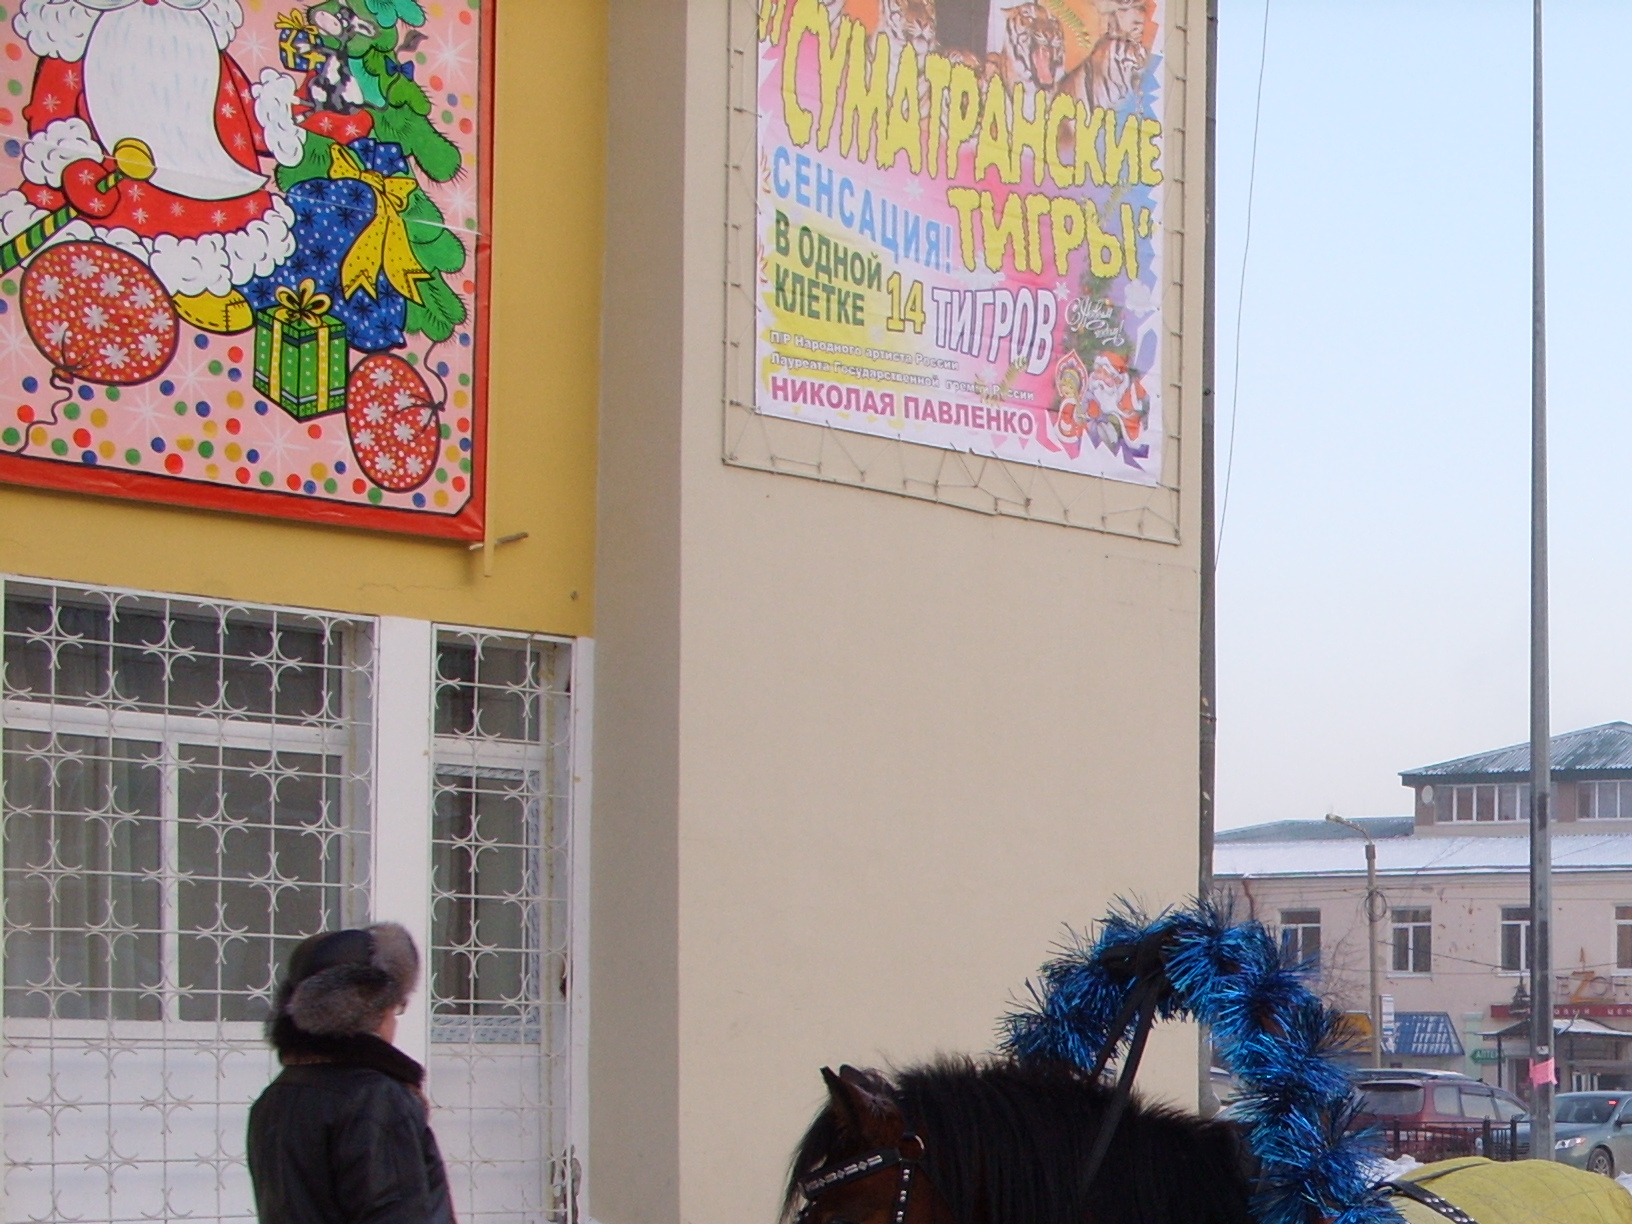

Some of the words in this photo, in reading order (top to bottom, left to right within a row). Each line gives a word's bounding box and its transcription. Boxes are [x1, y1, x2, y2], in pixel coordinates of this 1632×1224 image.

[772, 146, 953, 275] СЕНСАЦИЯ!
[775, 209, 790, 257] В
[799, 225, 883, 293] ОДНОЙ
[774, 263, 866, 327] КЛЕТКЕ
[887, 271, 926, 334] 14
[932, 287, 1058, 376] ТИГРОВ
[794, 334, 862, 357] Народного
[865, 348, 913, 365] артиста
[915, 354, 959, 371] России
[771, 352, 830, 372] Лауреата
[833, 361, 940, 387] Государственной
[992, 383, 1035, 400] Рссии
[771, 376, 896, 418] НИКОЛАЯ
[904, 394, 1034, 436] ПАВЛЕНКО
